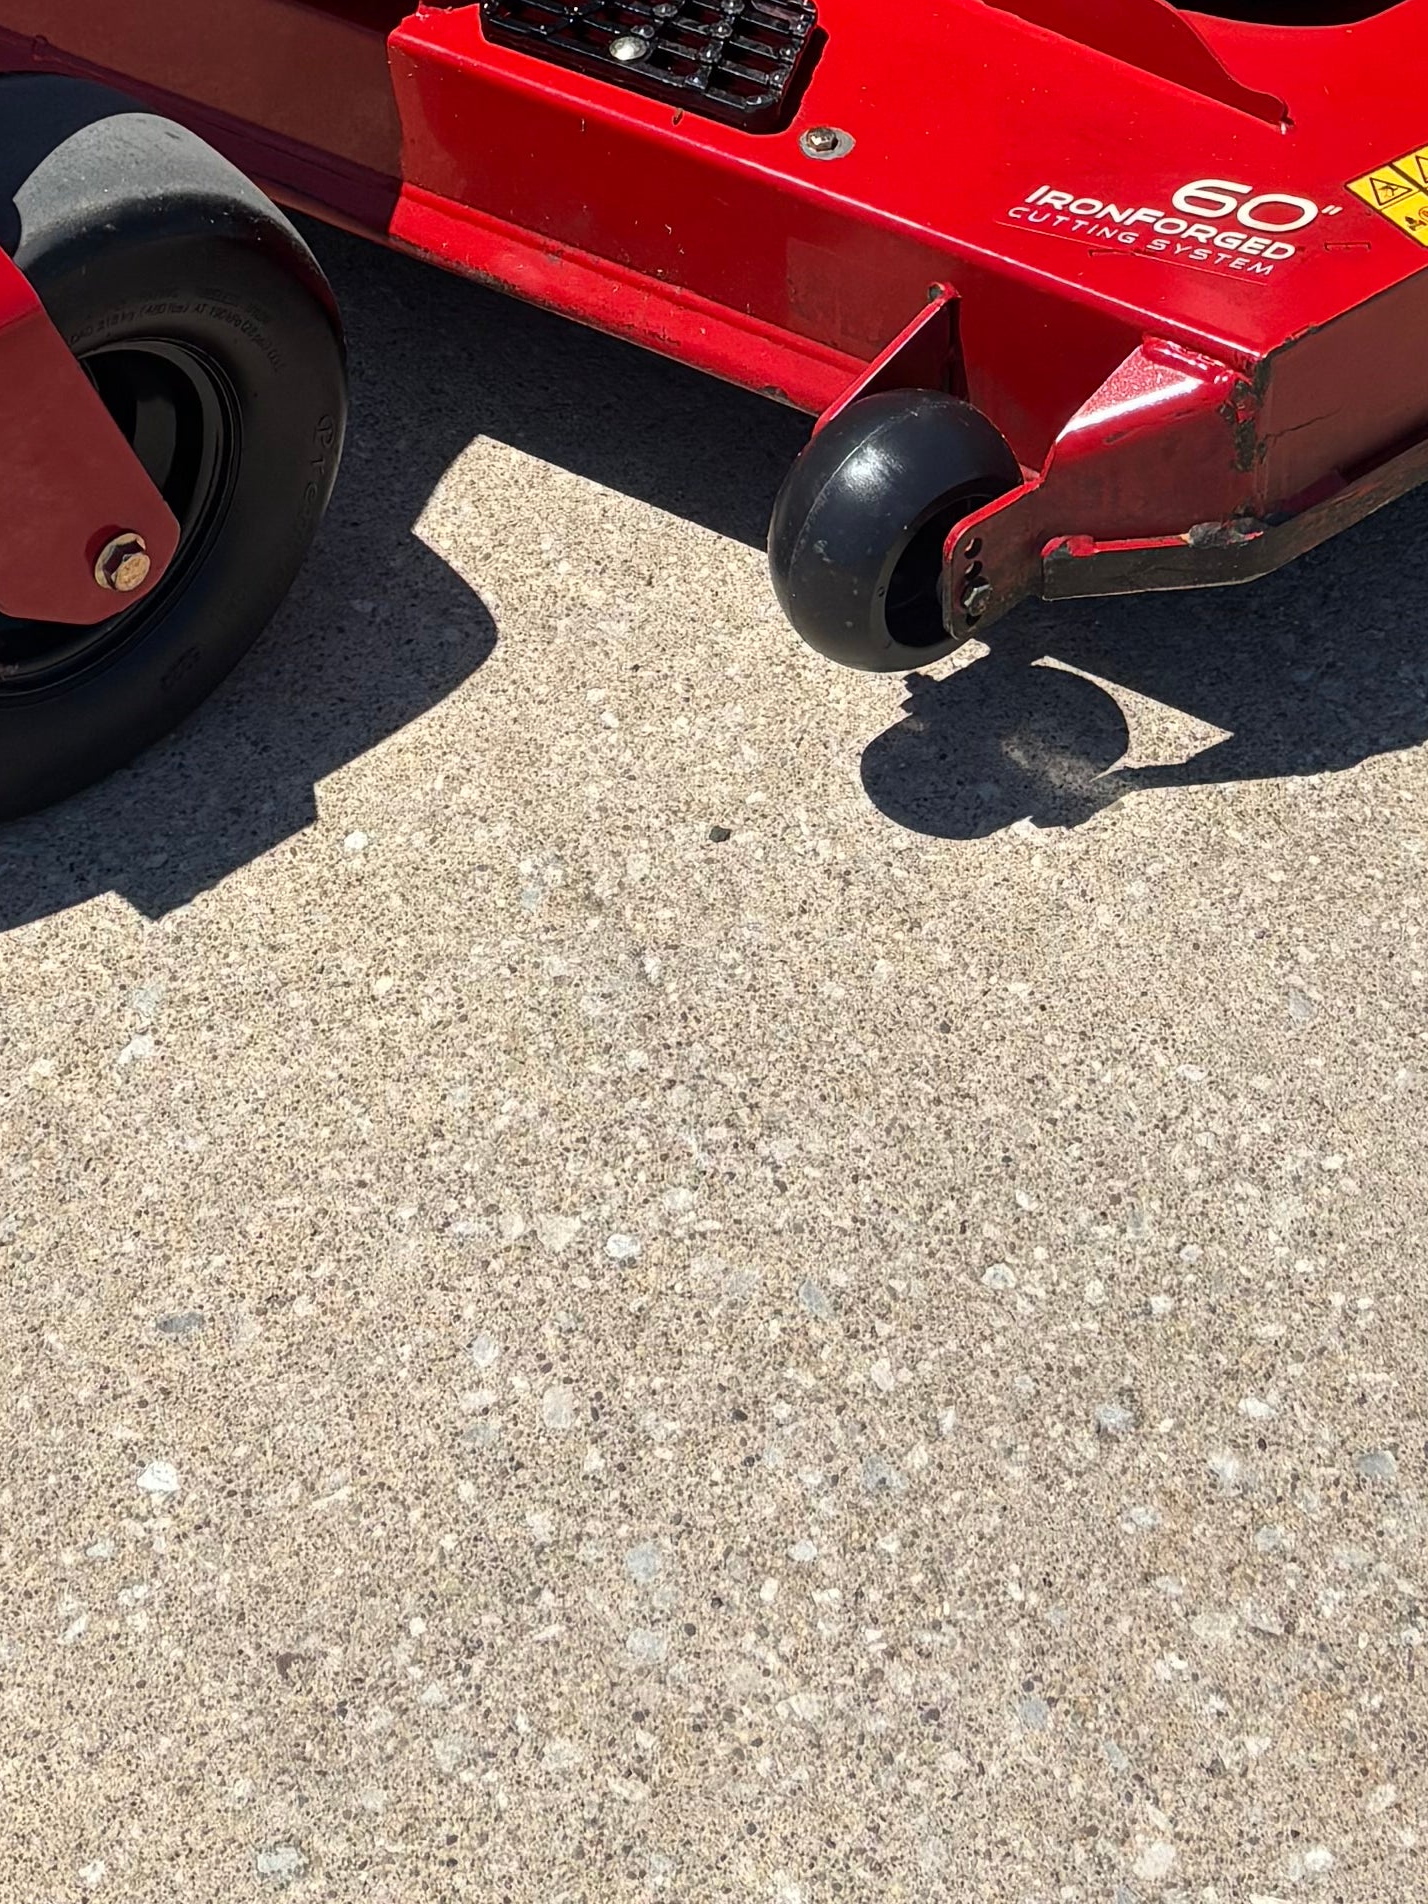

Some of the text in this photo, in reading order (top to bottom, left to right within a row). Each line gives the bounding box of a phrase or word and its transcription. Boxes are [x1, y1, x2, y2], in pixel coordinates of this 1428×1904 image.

[1006, 205, 1275, 276] CUTTING SYSTEM
[1024, 184, 1297, 261] IRONFORGED
[1171, 177, 1344, 234] 60"
